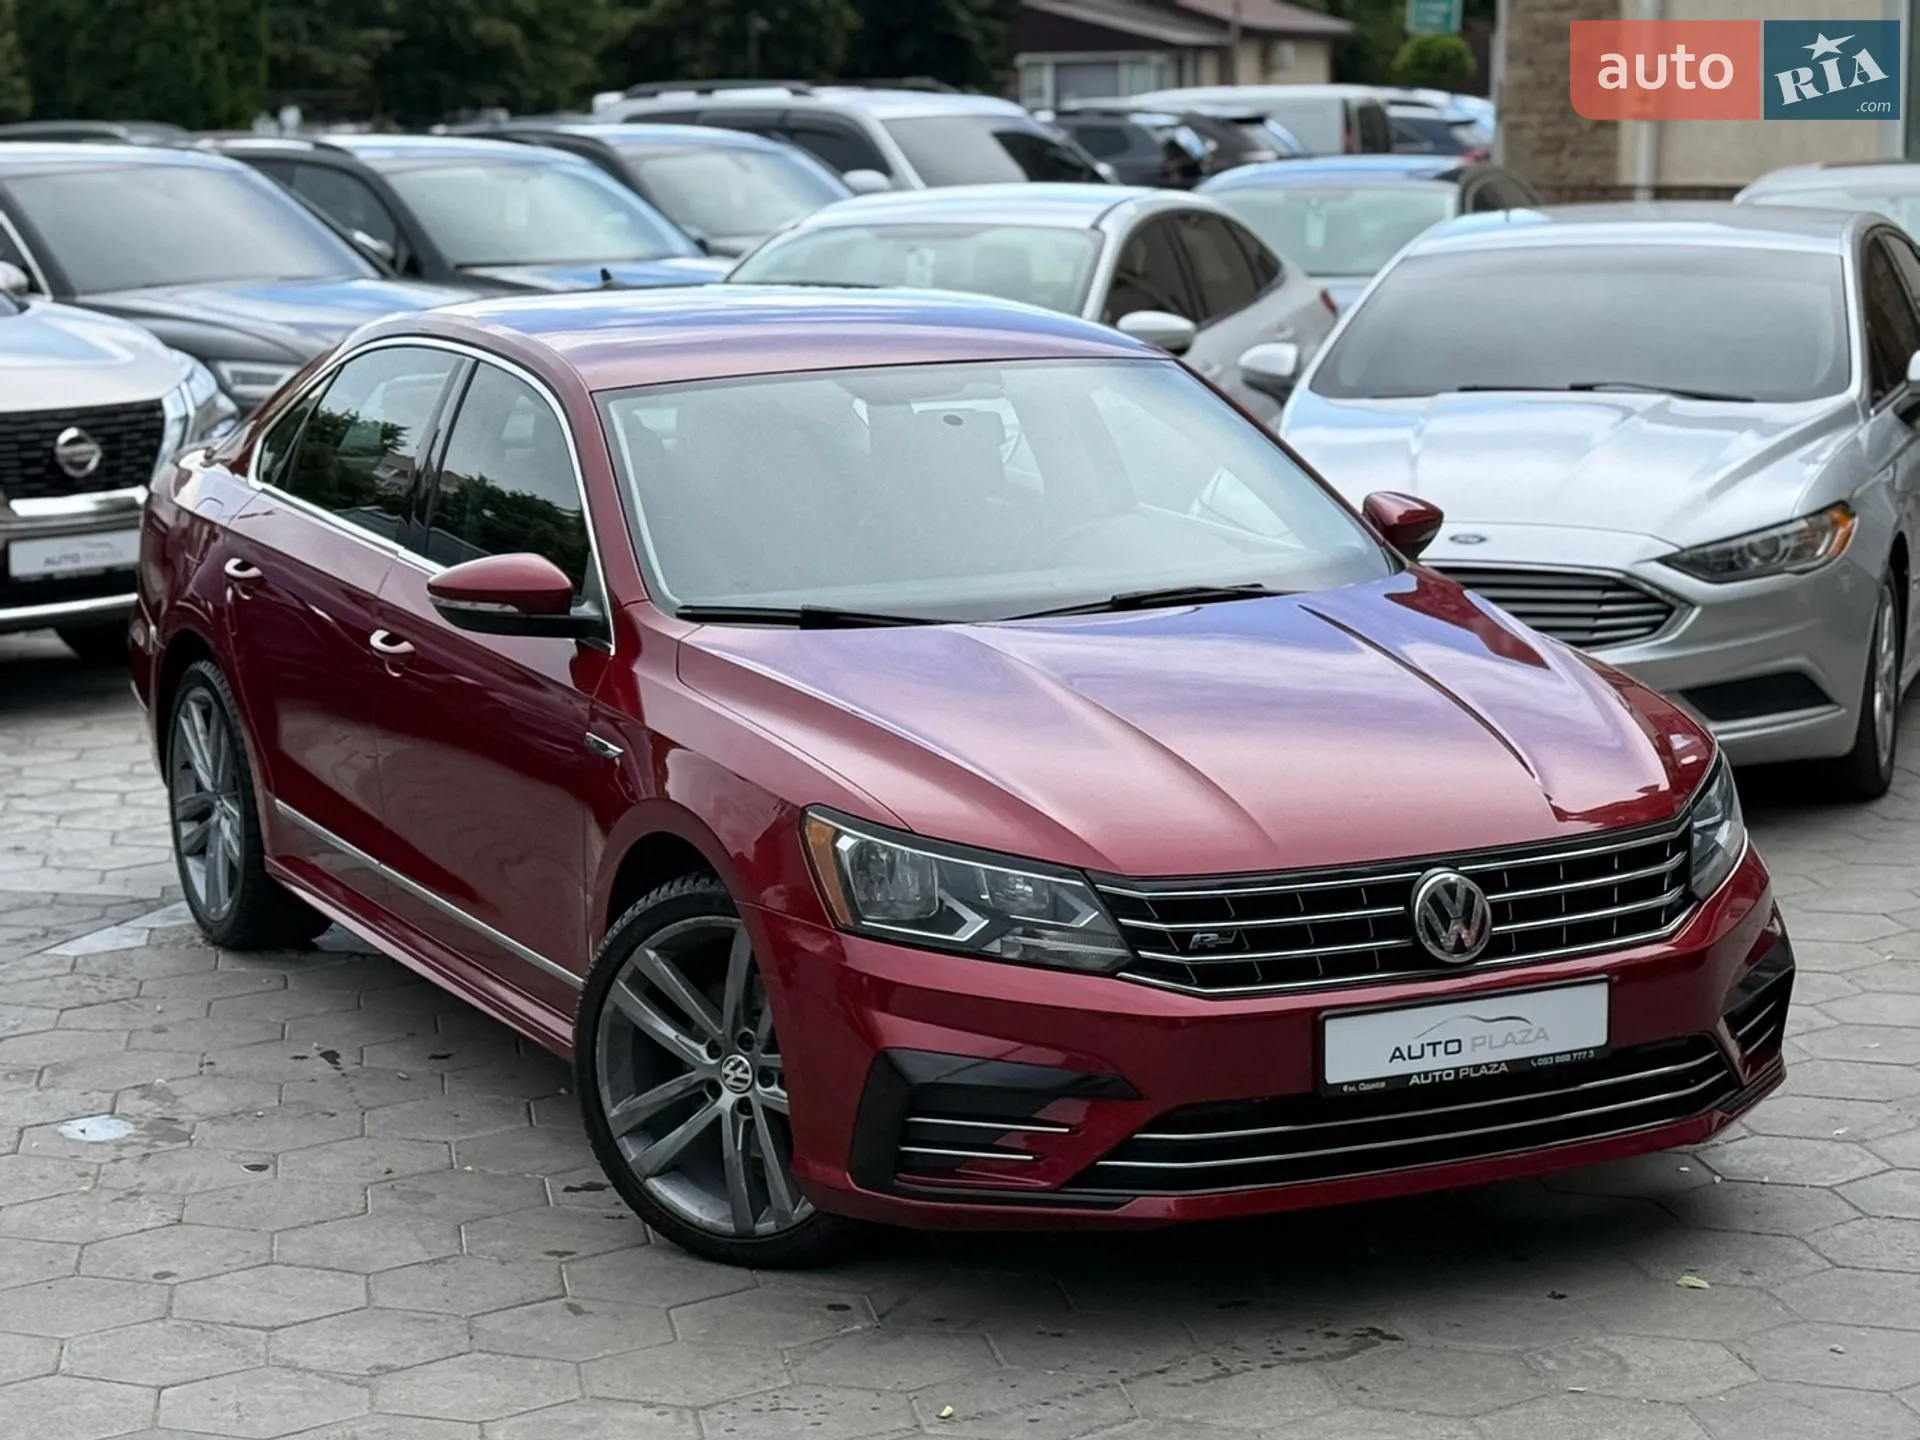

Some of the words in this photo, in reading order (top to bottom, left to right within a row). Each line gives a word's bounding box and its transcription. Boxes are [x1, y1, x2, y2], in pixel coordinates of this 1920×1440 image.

[1389, 1038, 1462, 1063] AUTO
[1470, 1027, 1550, 1052] PLAZA
[1408, 1069, 1455, 1086] AUTO
[1458, 1062, 1509, 1080] PLAZA
